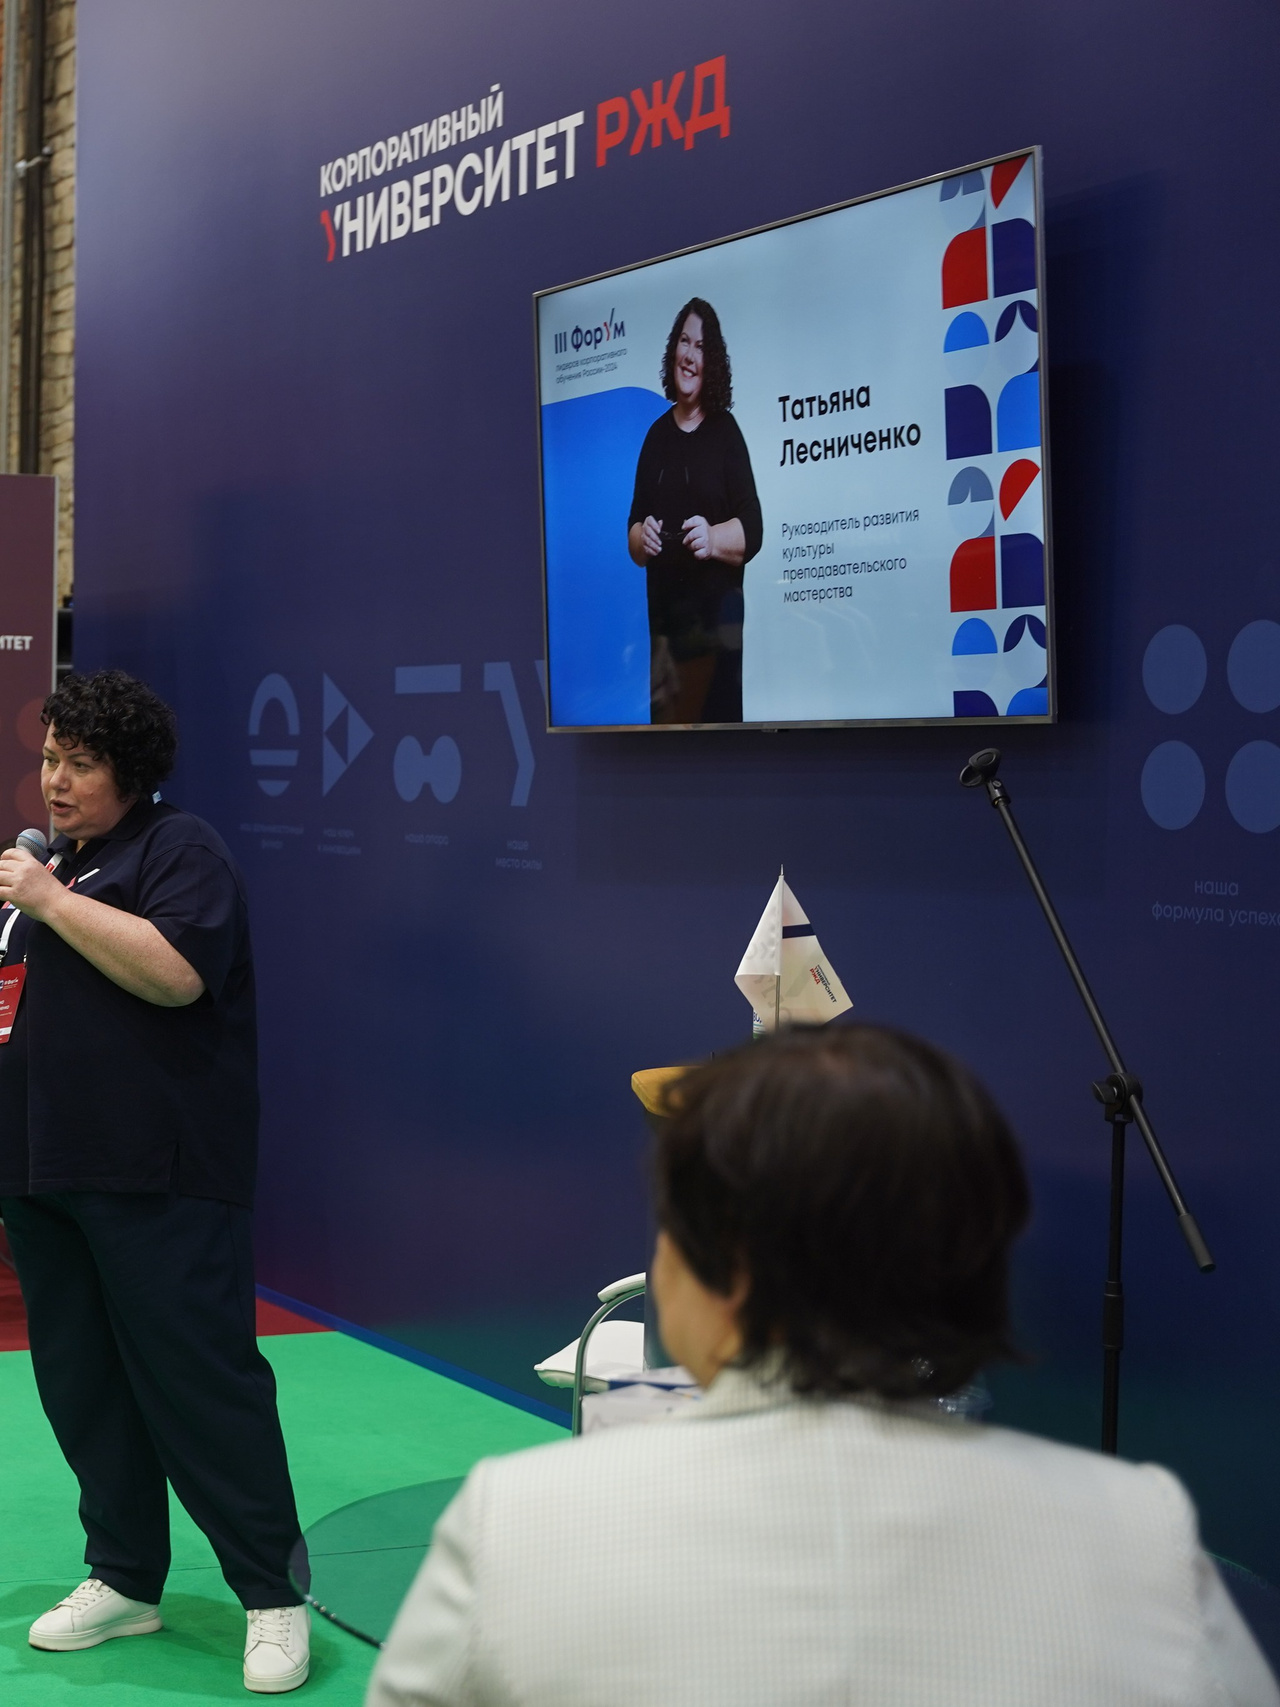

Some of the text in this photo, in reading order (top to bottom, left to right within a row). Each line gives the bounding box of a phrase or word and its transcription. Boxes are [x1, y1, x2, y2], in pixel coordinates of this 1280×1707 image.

[320, 83, 504, 198] КОРПОРАТИВНЫЙ
[320, 54, 731, 262] УНИВЕРСИТЕТ РЖД
[554, 331, 567, 354] III
[778, 385, 870, 422] Татьяна
[780, 423, 921, 467] Лесниченко
[781, 509, 920, 541] Руководитель развития
[782, 542, 835, 562] культуры
[783, 557, 907, 583] преподавательского
[783, 586, 853, 603] мастерства
[1194, 880, 1239, 896] наша
[1151, 900, 1225, 925] формула
